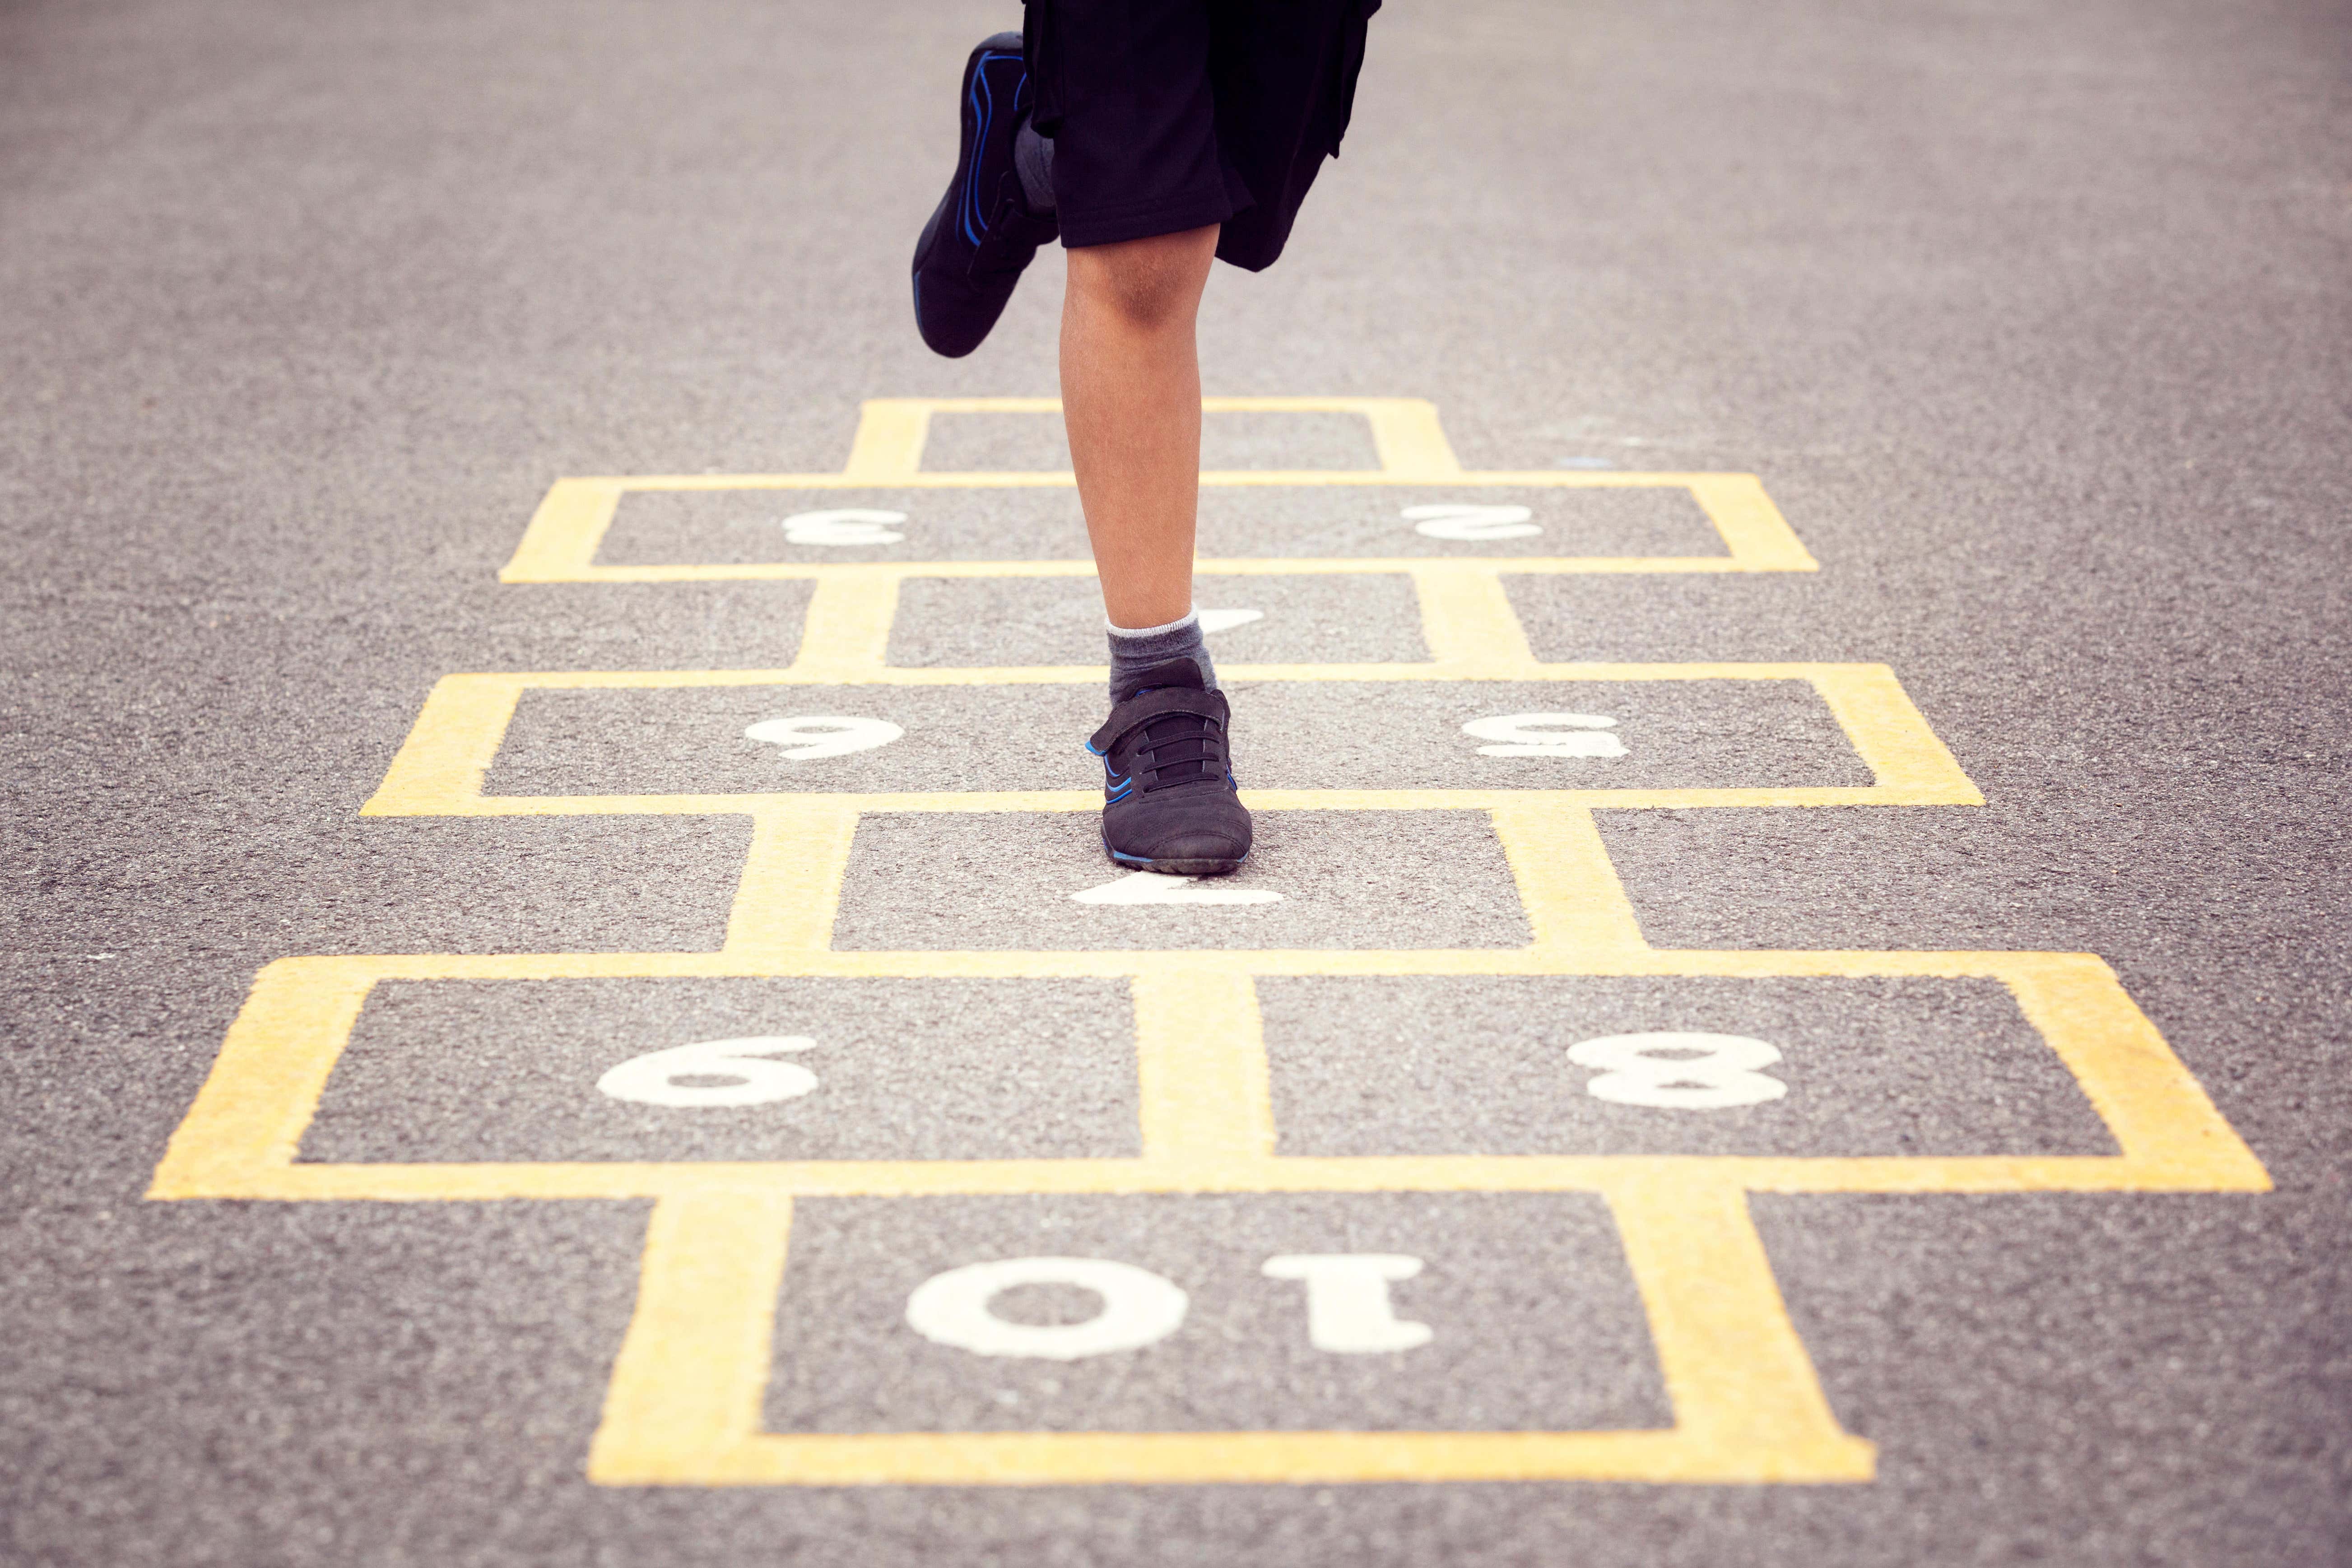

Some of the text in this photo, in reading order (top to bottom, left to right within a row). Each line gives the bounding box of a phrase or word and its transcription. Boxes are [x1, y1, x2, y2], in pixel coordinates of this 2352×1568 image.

[784, 510, 906, 545] 3
[1400, 505, 1542, 540] 2
[745, 717, 905, 759] 6
[1462, 712, 1629, 758] 5
[597, 1036, 818, 1108] 9
[1566, 1032, 1788, 1109] 8
[905, 1254, 1433, 1359] 10
